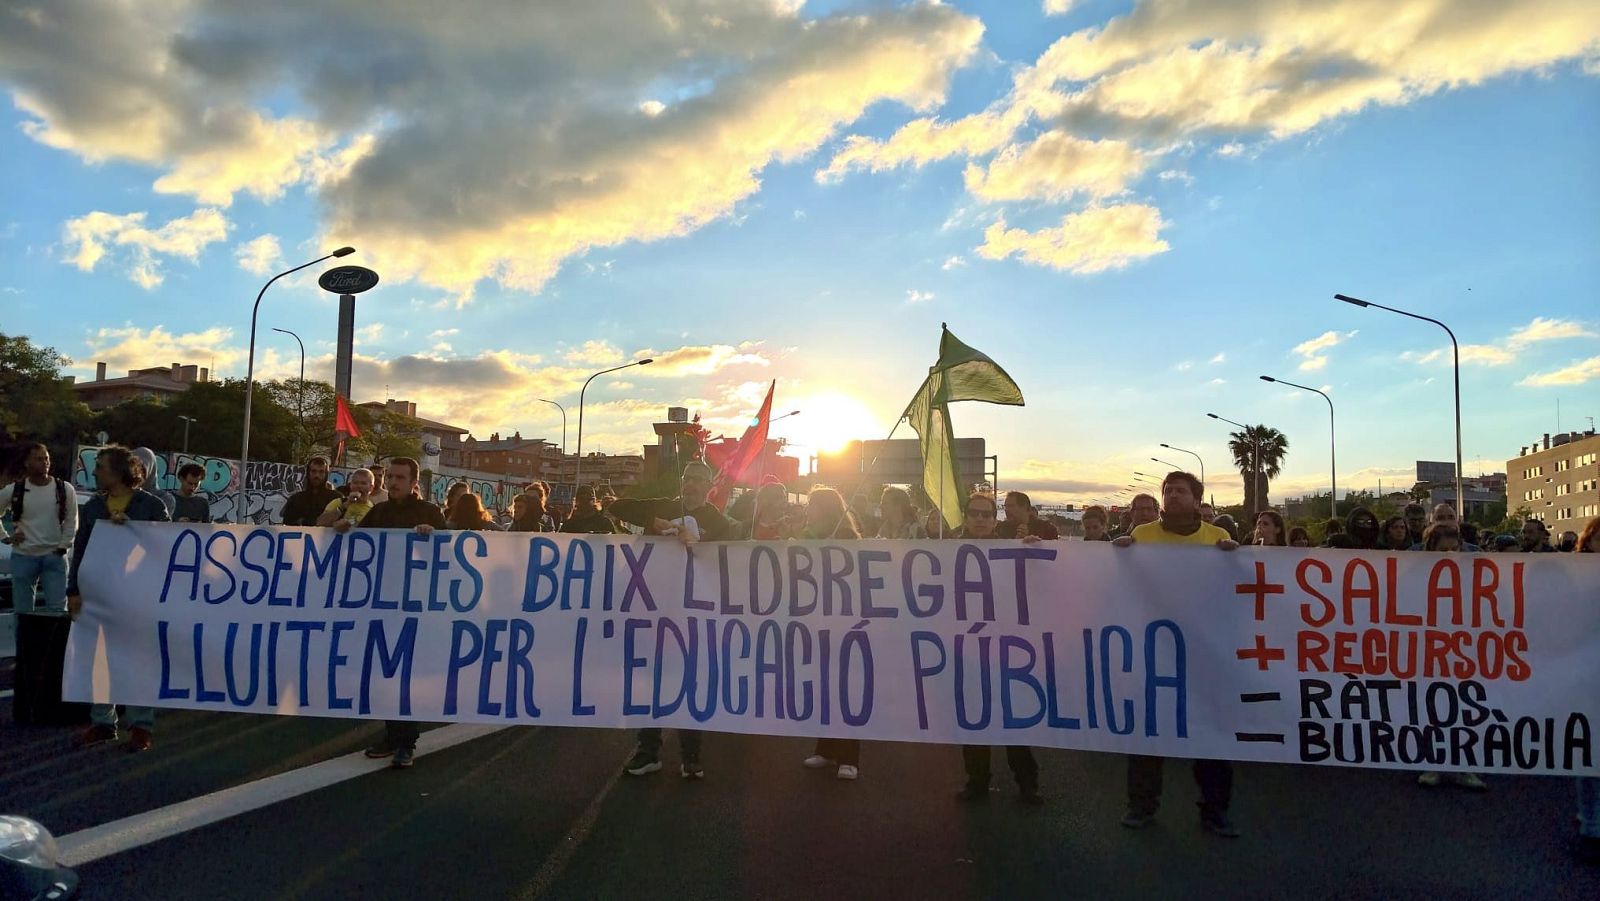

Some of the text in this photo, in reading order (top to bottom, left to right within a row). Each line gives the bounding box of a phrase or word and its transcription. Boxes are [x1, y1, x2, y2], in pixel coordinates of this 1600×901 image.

[159, 528, 1057, 626] ASSEMBLEES BAIX LLOBREGAT
[1235, 558, 1525, 628] + SALARI
[158, 616, 1189, 739] LLUITEM PER L'EDUCACIÓ PÚBLICA
[1236, 628, 1531, 682] + RECURSOS
[1300, 673, 1490, 727] RÀTIOS
[1298, 709, 1592, 769] BUROCRÀCIA
